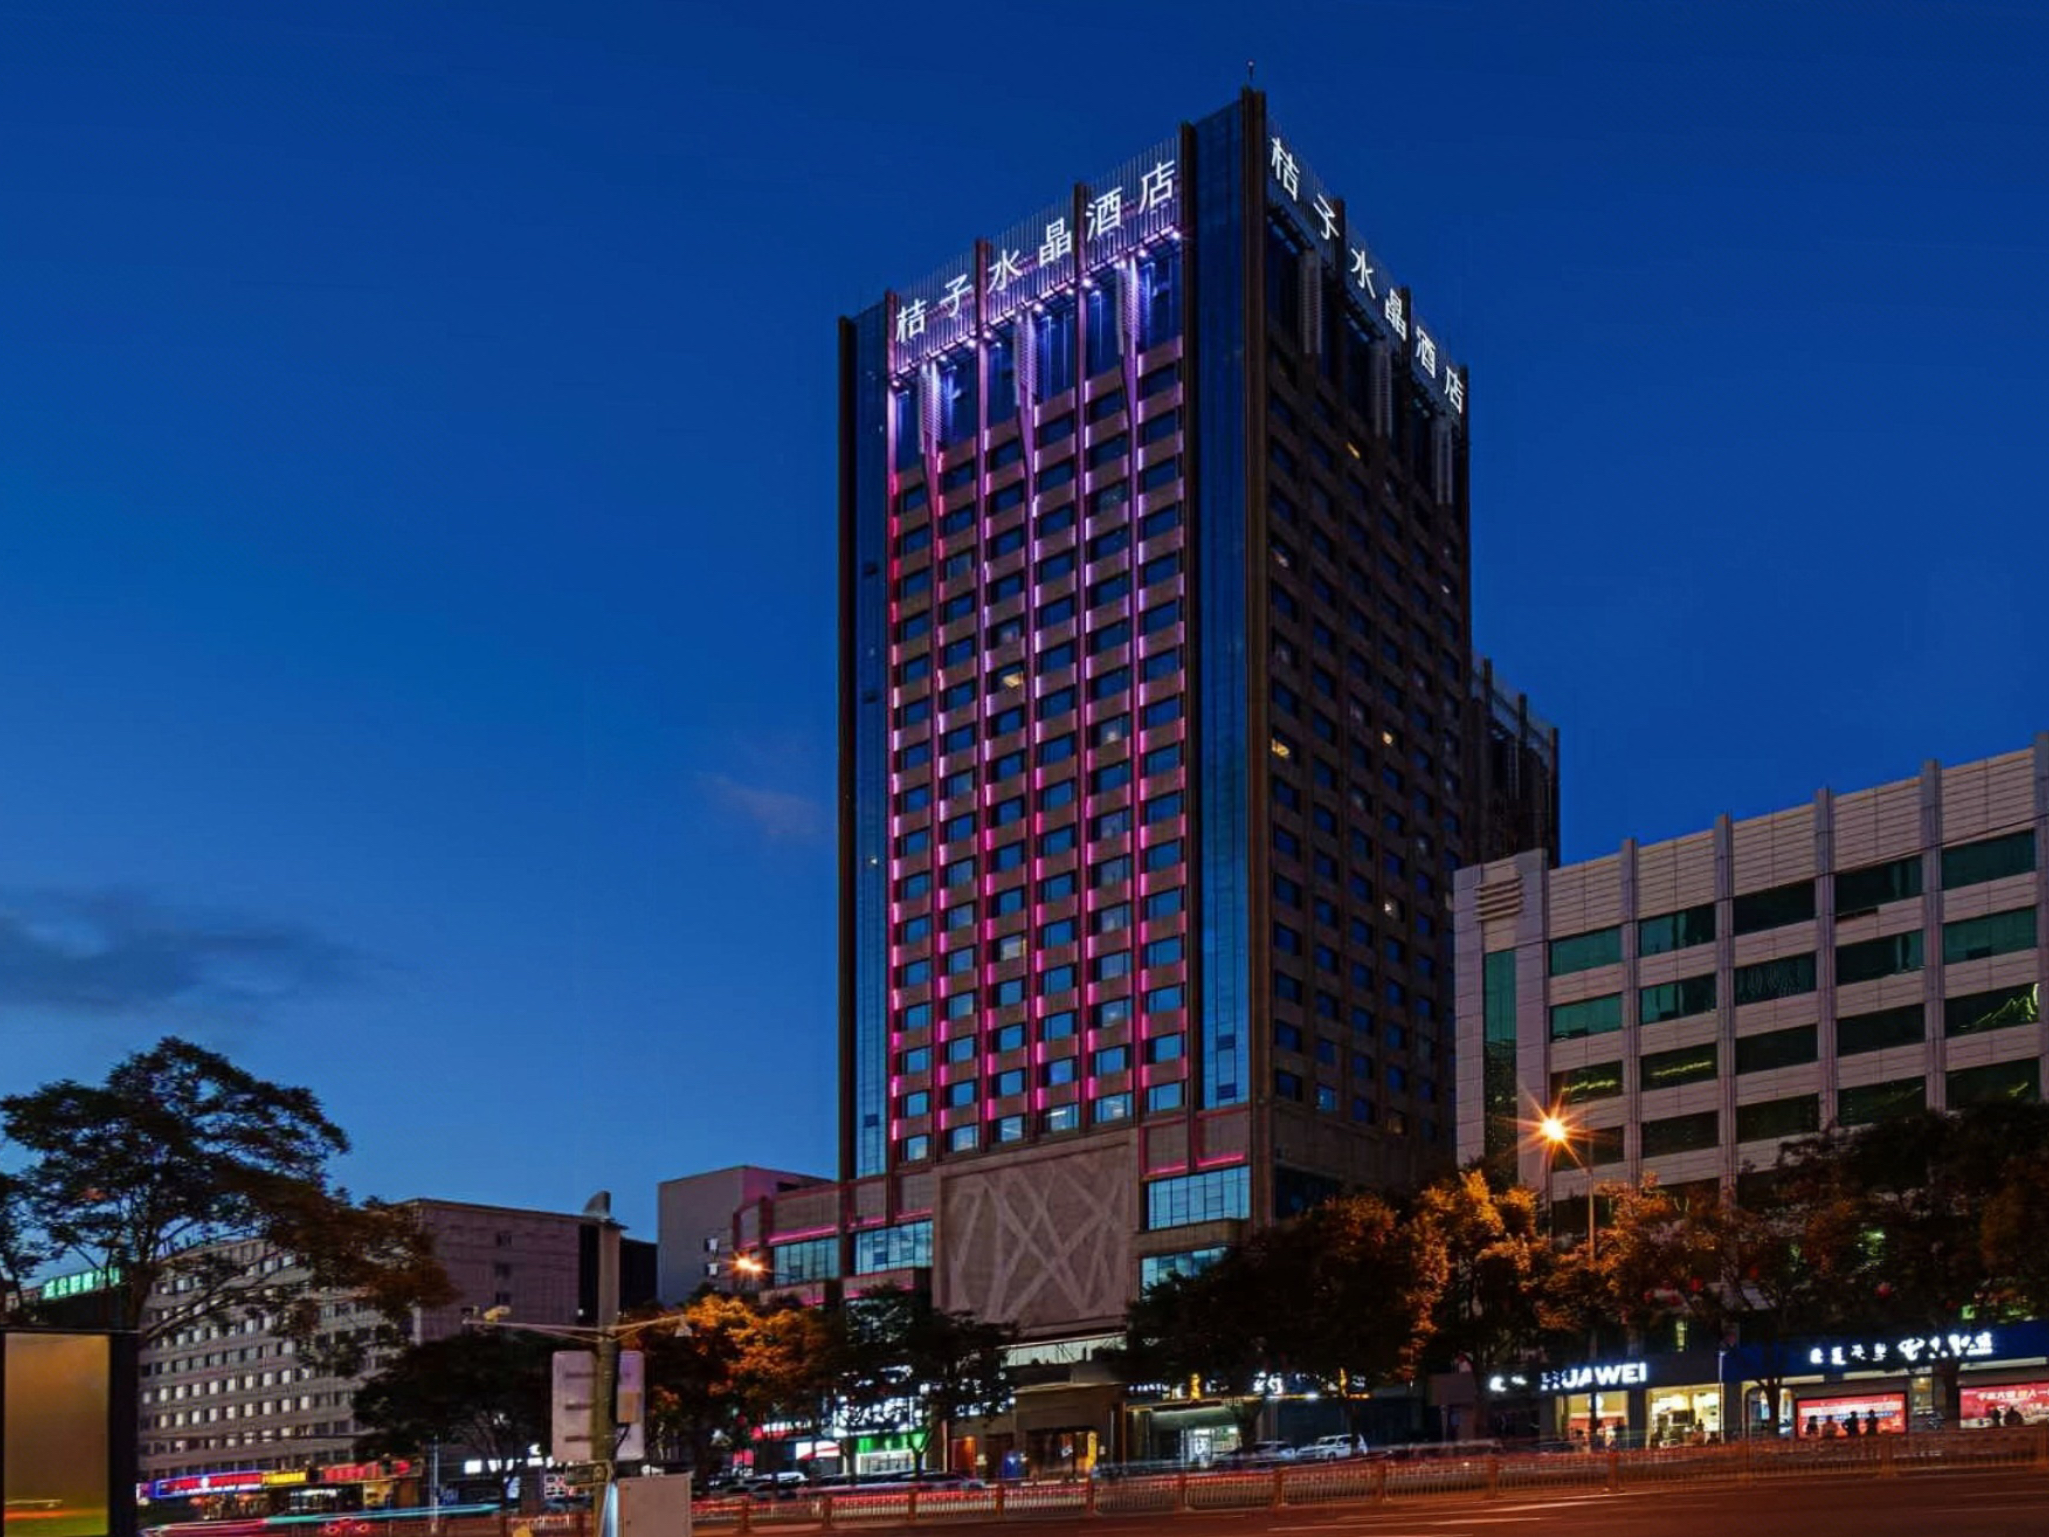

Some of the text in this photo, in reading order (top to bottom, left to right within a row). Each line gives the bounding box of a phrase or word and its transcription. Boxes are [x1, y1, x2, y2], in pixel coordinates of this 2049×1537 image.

[896, 160, 1175, 343] 桔子水晶酒店
[1271, 137, 1464, 414] 桔子水晶酒店
